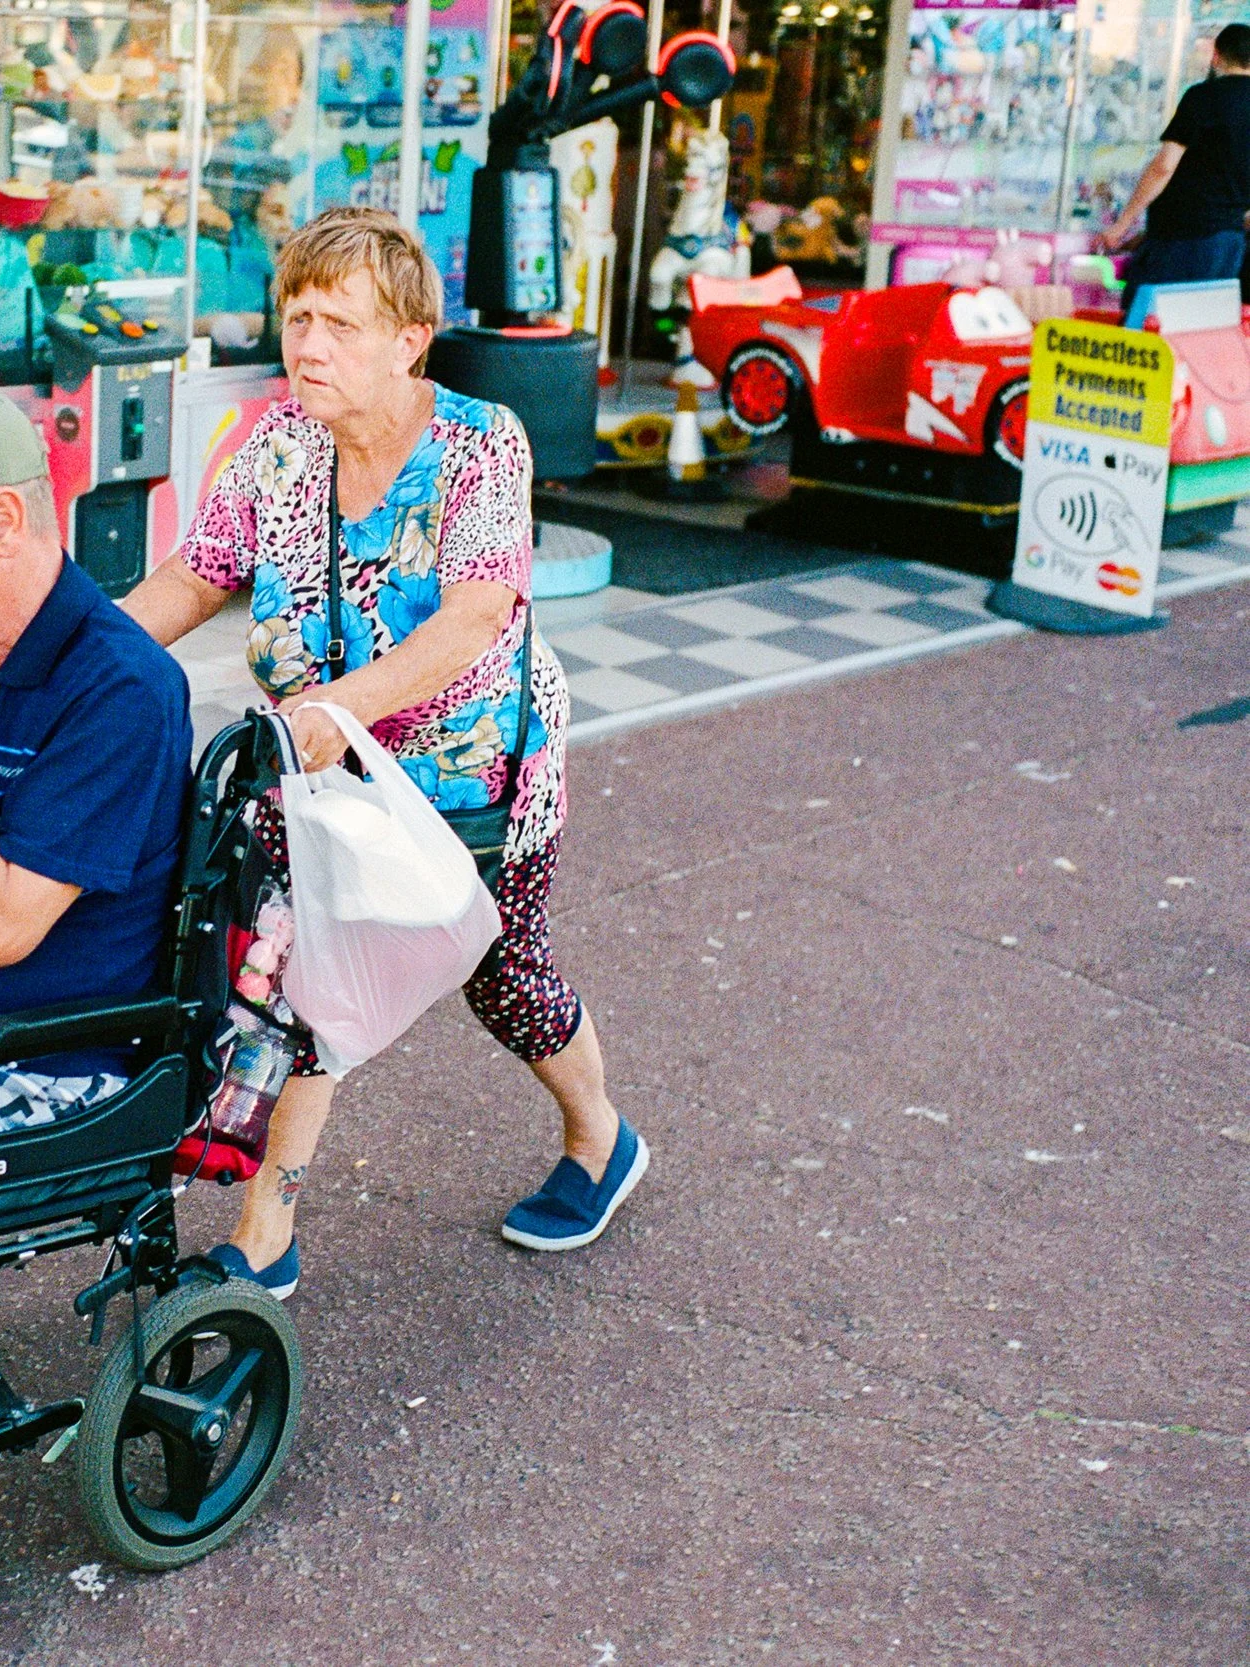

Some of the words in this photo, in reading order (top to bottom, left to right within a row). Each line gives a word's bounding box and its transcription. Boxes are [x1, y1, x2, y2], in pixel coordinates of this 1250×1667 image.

[350, 177, 449, 218] GREN!
[1046, 326, 1160, 371] Contactless
[1054, 361, 1147, 401] Payments
[1054, 394, 1143, 433] Accepted
[1037, 435, 1091, 466] VISA
[1123, 452, 1163, 486] Pay
[1051, 550, 1087, 586] Pay
